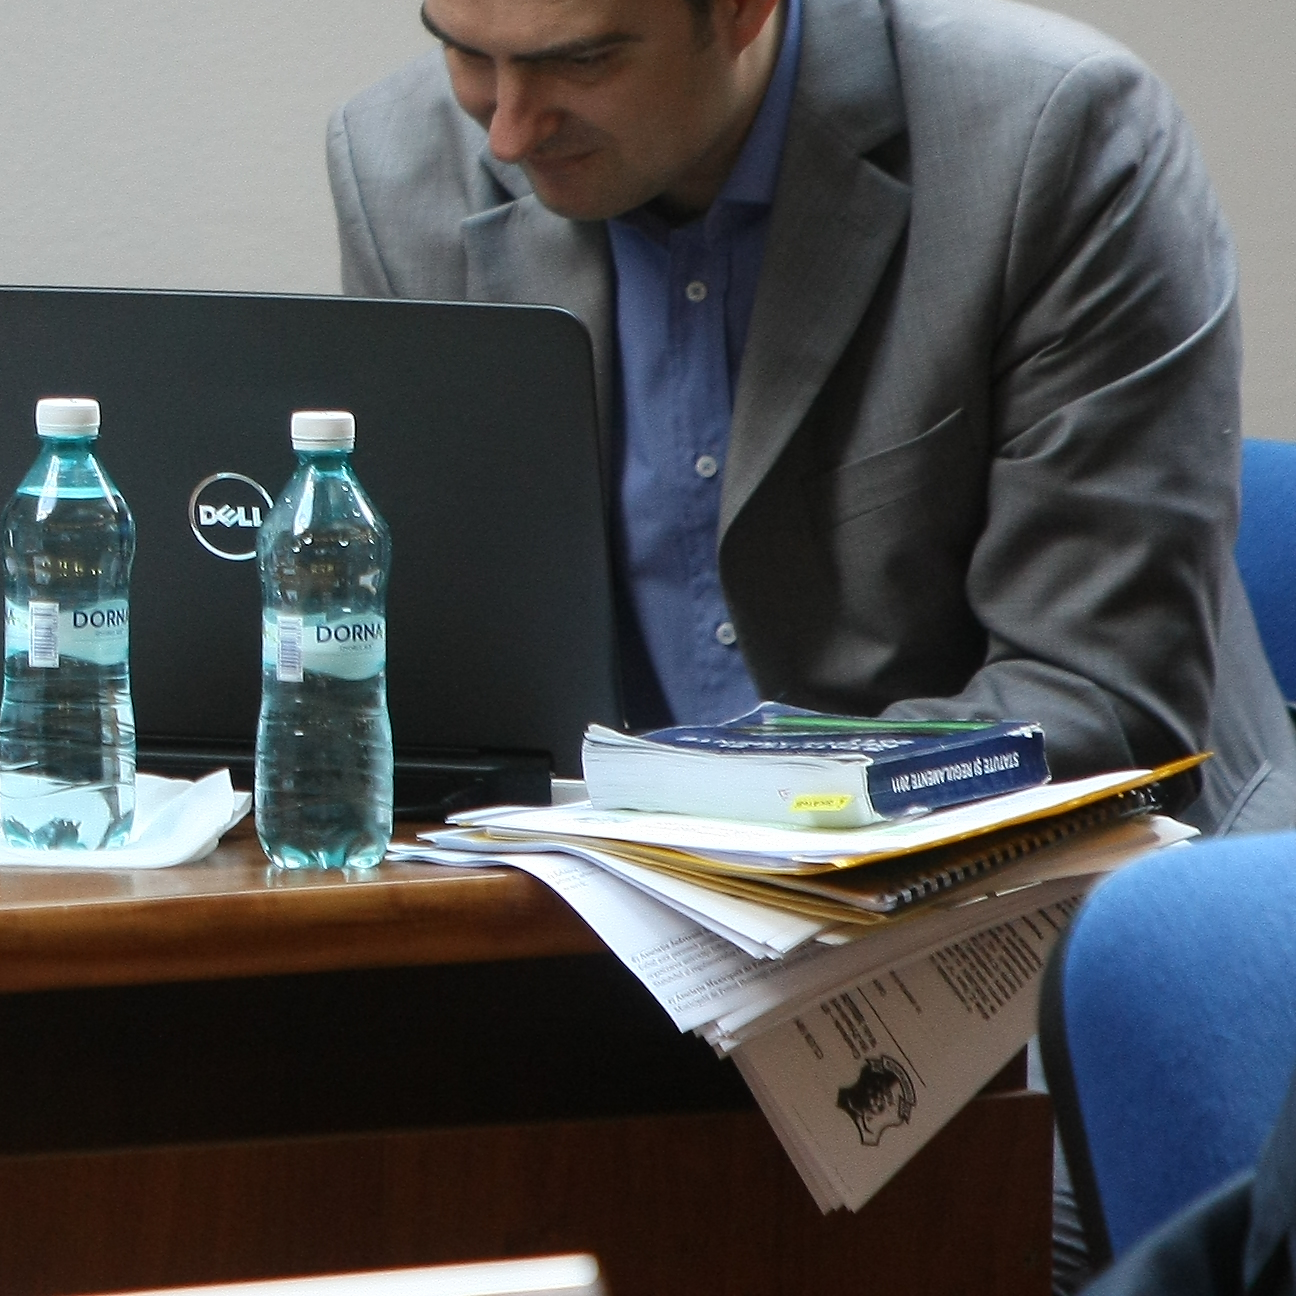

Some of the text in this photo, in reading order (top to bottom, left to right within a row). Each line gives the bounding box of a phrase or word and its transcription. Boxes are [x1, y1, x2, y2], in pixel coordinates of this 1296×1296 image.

[198, 505, 264, 528] DELL
[316, 623, 384, 644] DORNA
[983, 751, 1020, 774] STATUTE
